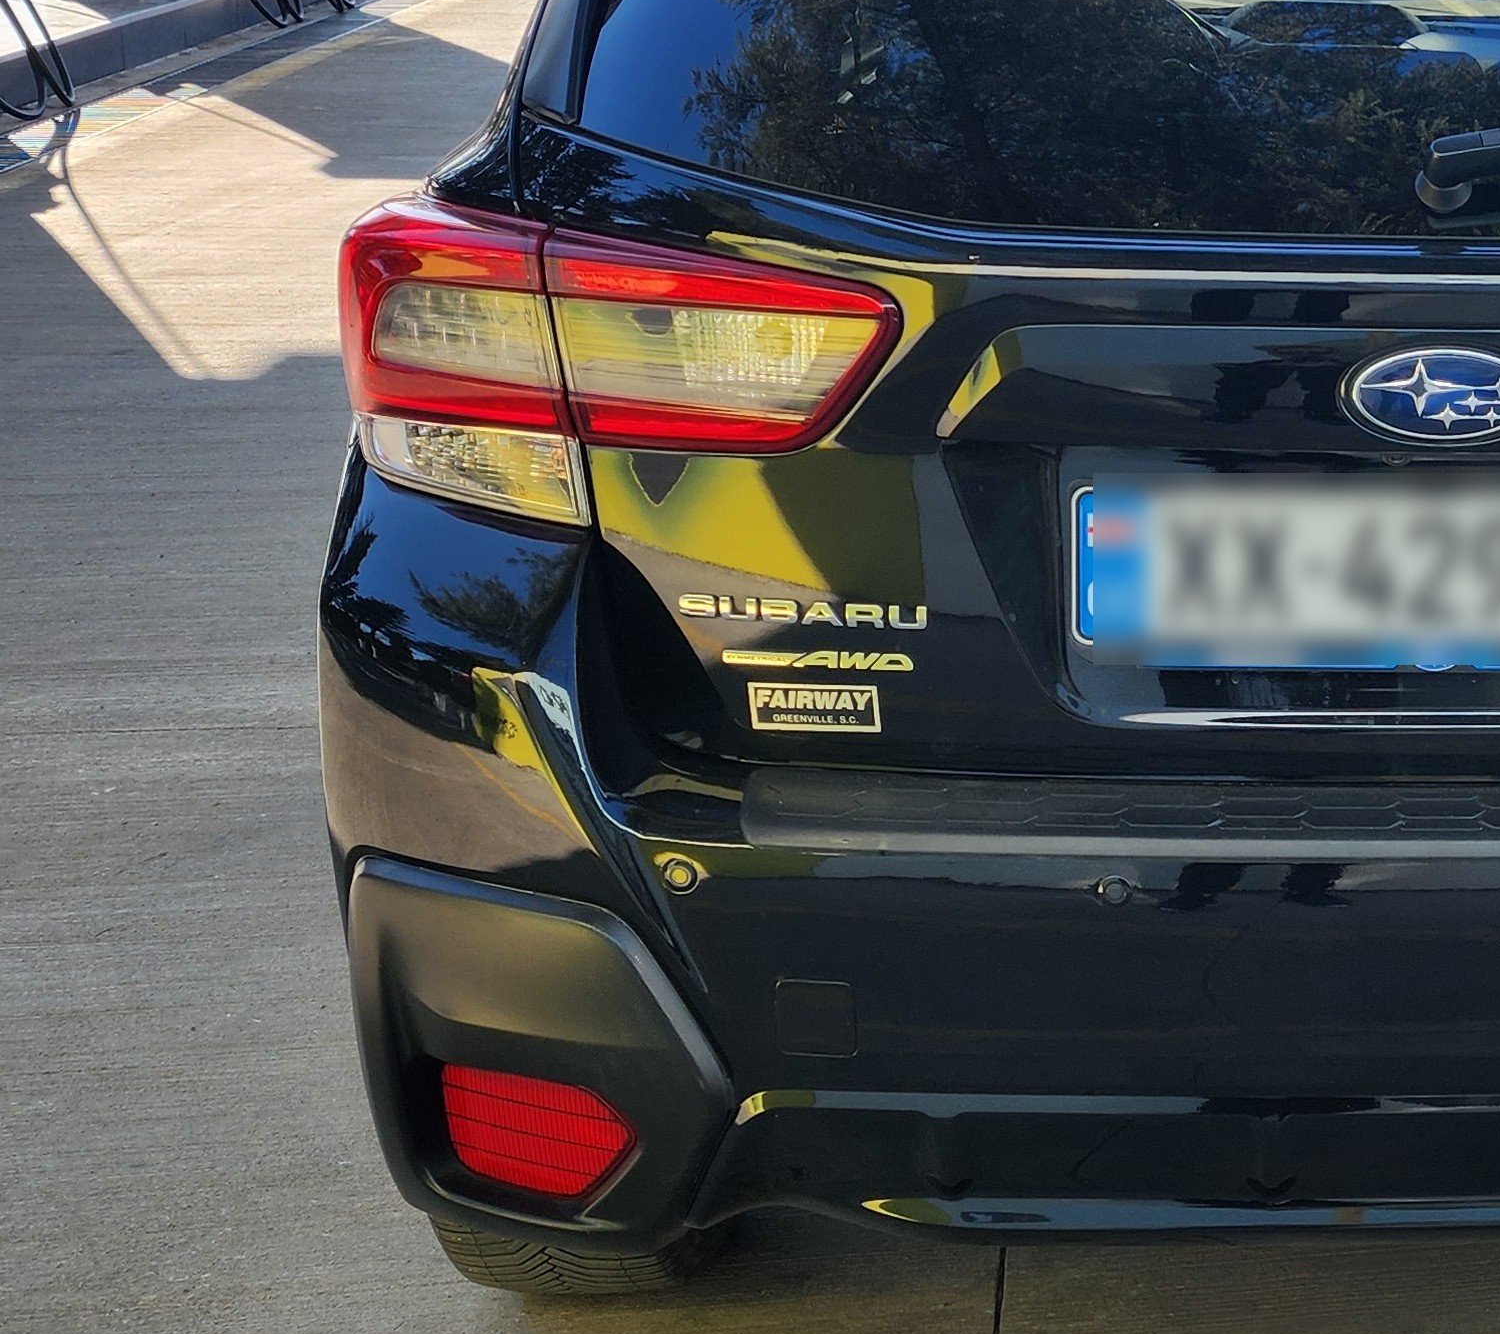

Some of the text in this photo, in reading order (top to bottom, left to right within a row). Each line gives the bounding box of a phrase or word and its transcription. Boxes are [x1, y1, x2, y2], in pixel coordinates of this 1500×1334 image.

[678, 592, 928, 630] SUBARU
[792, 650, 914, 672] AWD
[756, 688, 872, 711] FAIRWAY
[839, 714, 860, 724] S.C.
